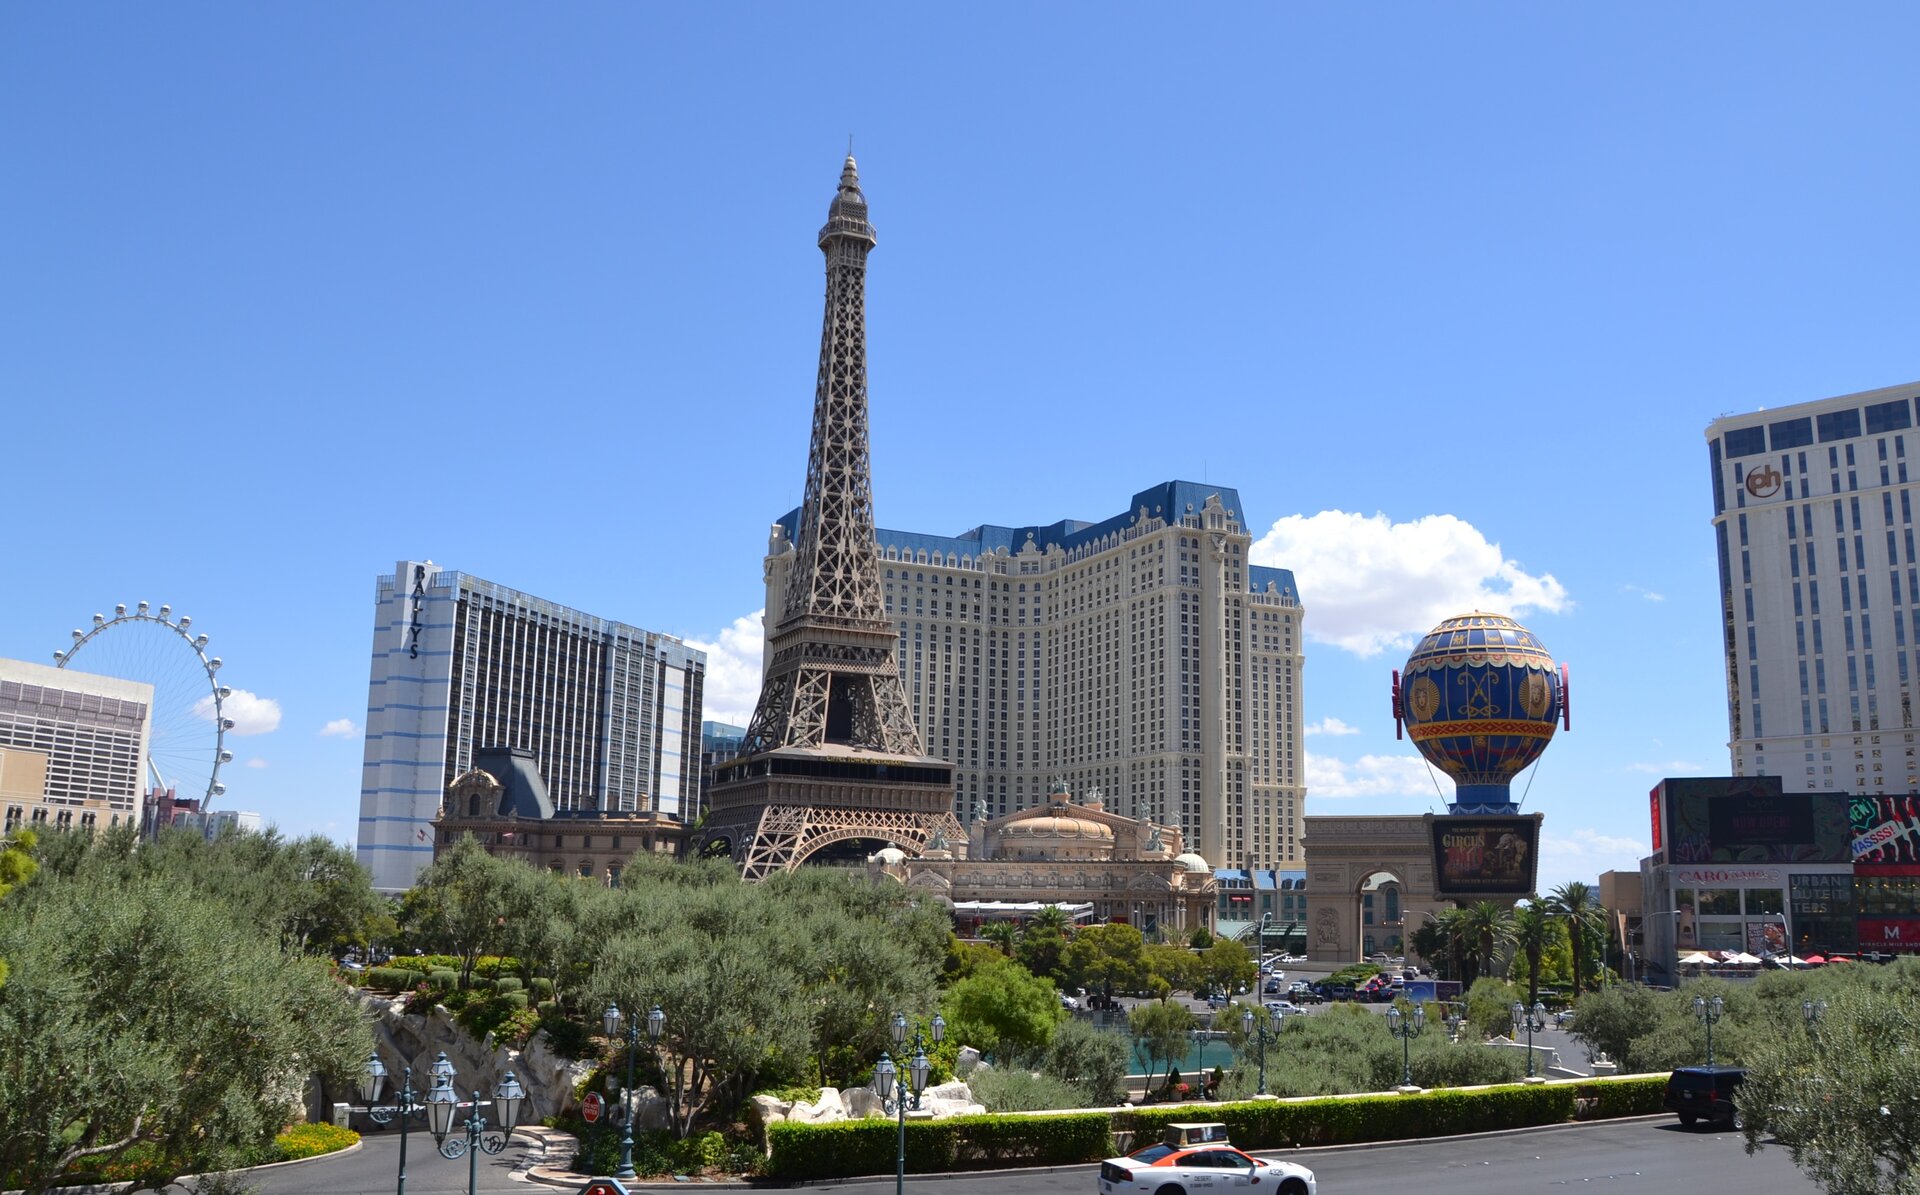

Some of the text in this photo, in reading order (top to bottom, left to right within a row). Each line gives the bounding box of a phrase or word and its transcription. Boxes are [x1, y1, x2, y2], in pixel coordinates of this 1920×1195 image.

[1850, 800, 1870, 822] NEW
[1442, 834, 1485, 848] CIRCUS
[1852, 825, 1896, 854] YASSSS!
[1679, 871, 1728, 882] CABO
[1792, 876, 1841, 887] URBAN
[1884, 926, 1900, 939] M
